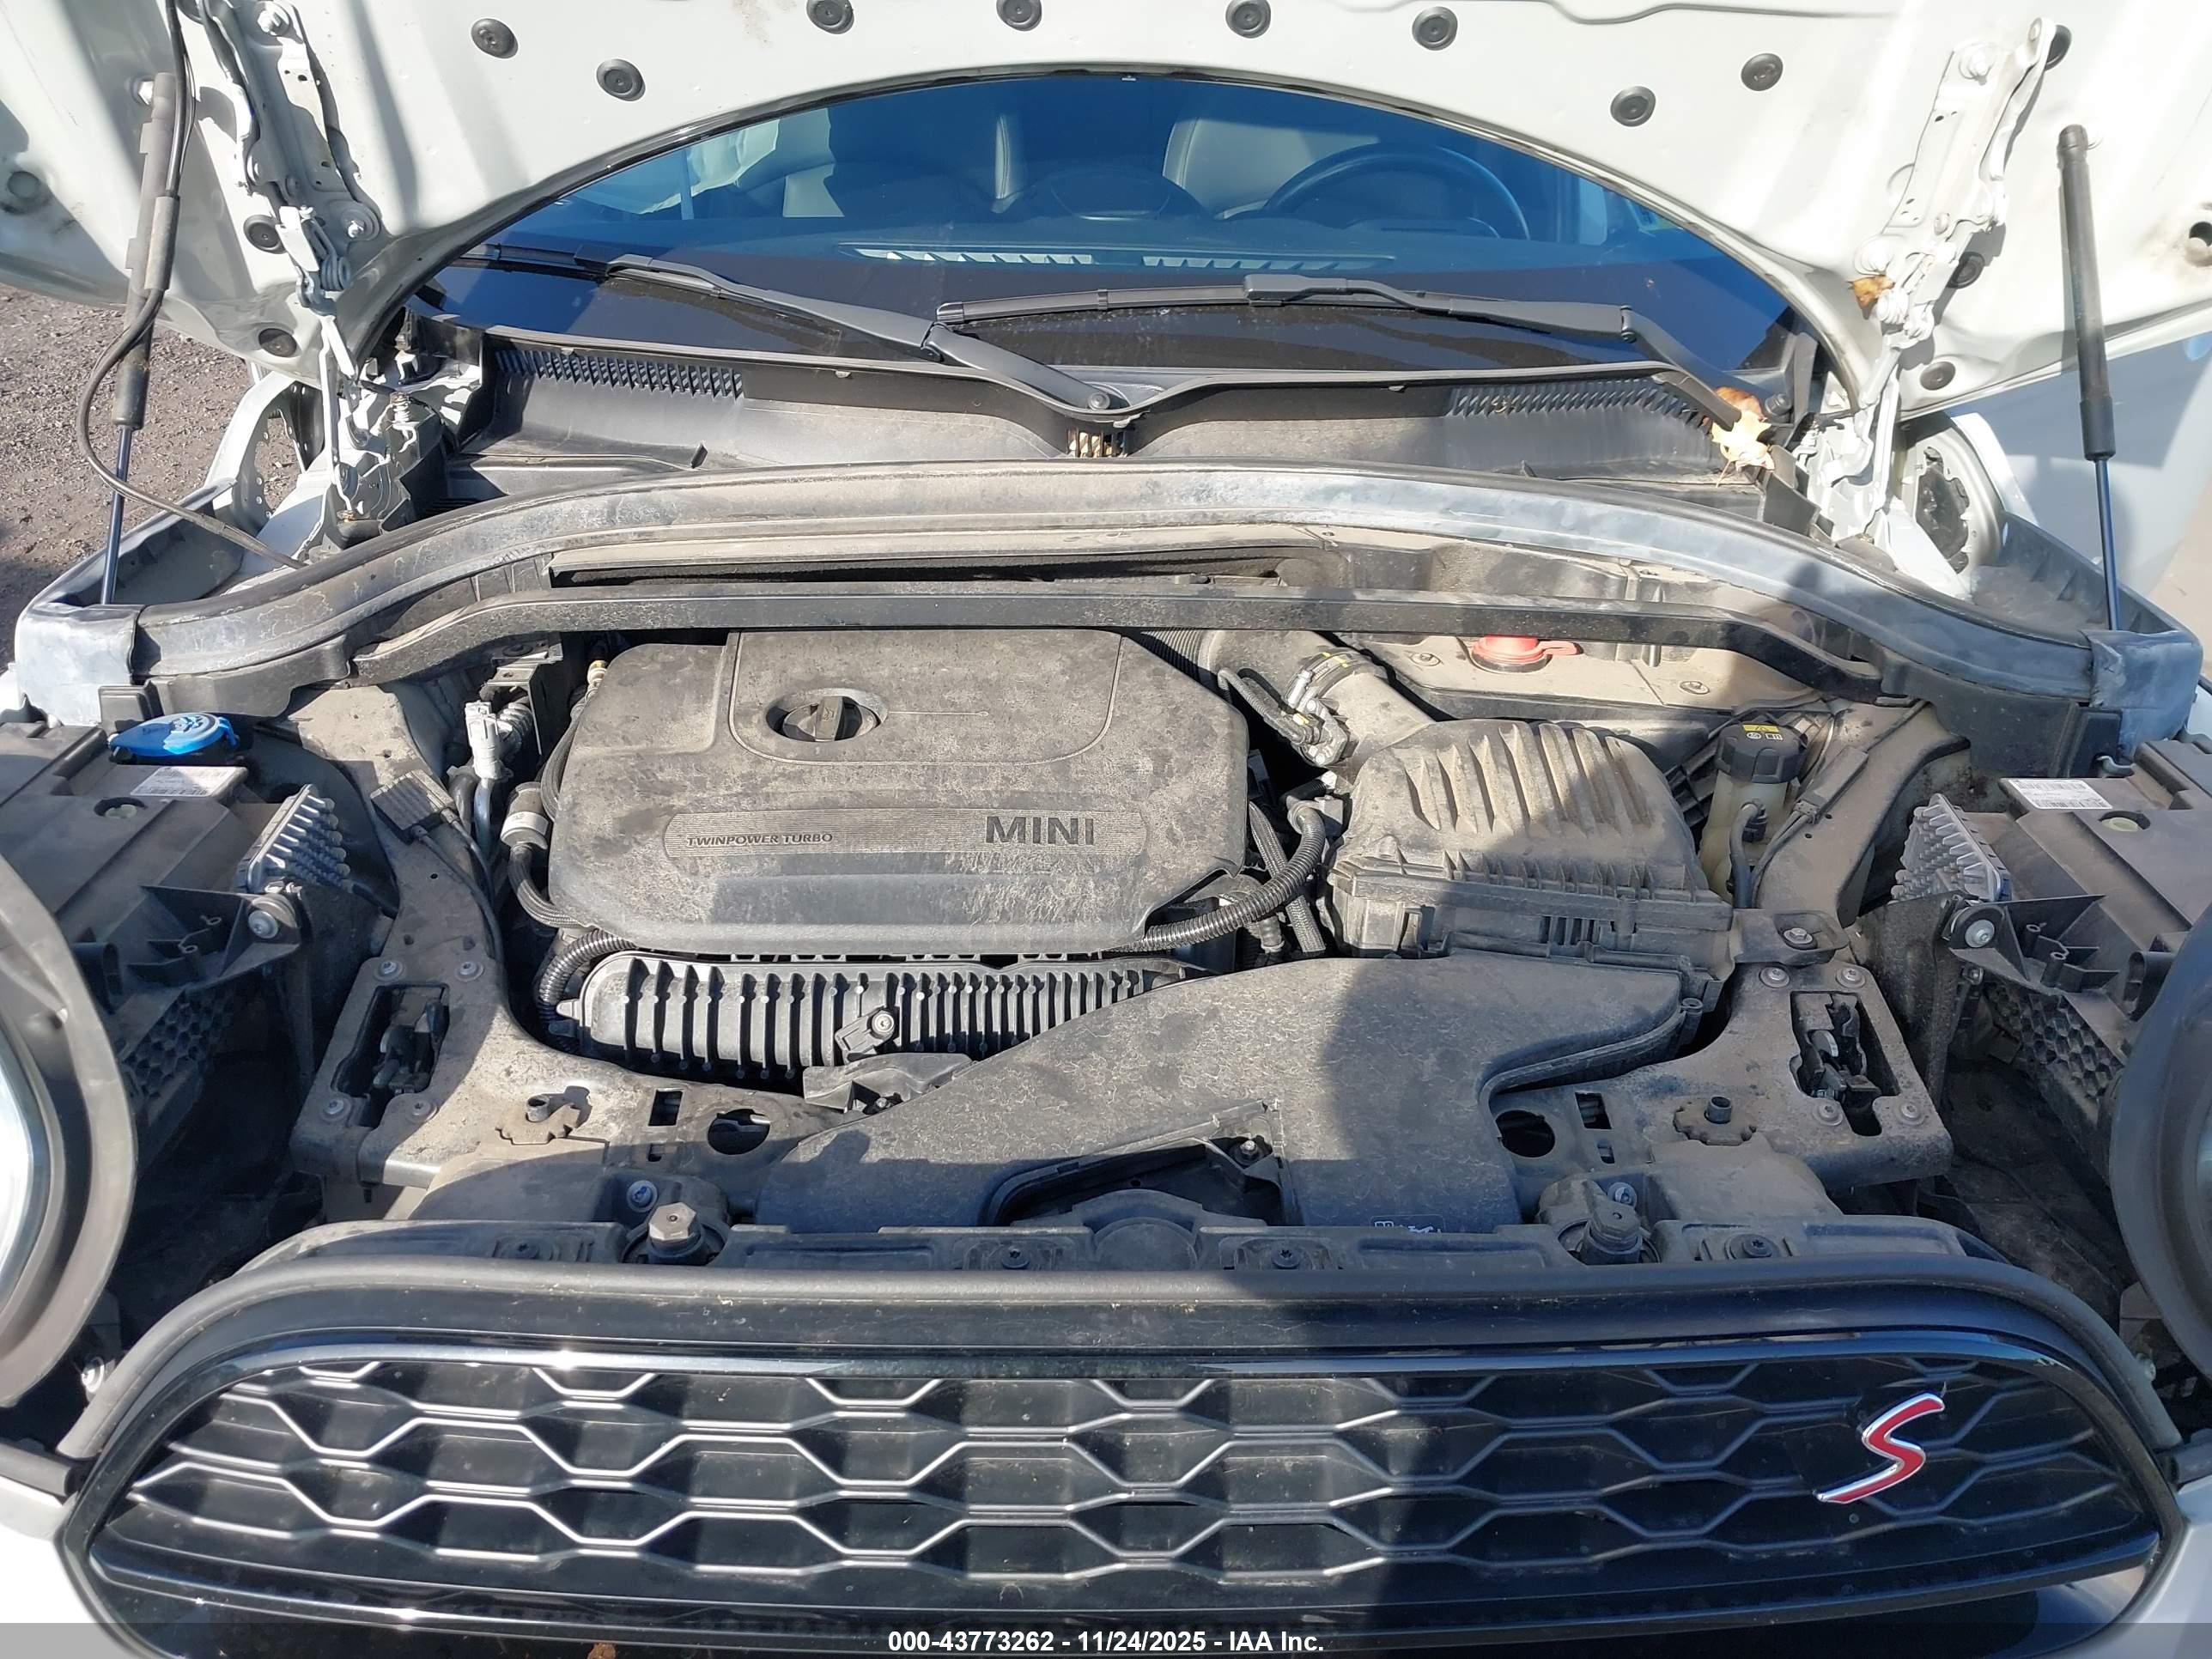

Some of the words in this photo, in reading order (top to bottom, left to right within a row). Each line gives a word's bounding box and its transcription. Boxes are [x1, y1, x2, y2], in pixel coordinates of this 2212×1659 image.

[687, 834, 778, 846] TWINPOWER
[783, 833, 833, 843] TURBO
[986, 817, 1094, 845] MINI
[1814, 1393, 1945, 1504] S
